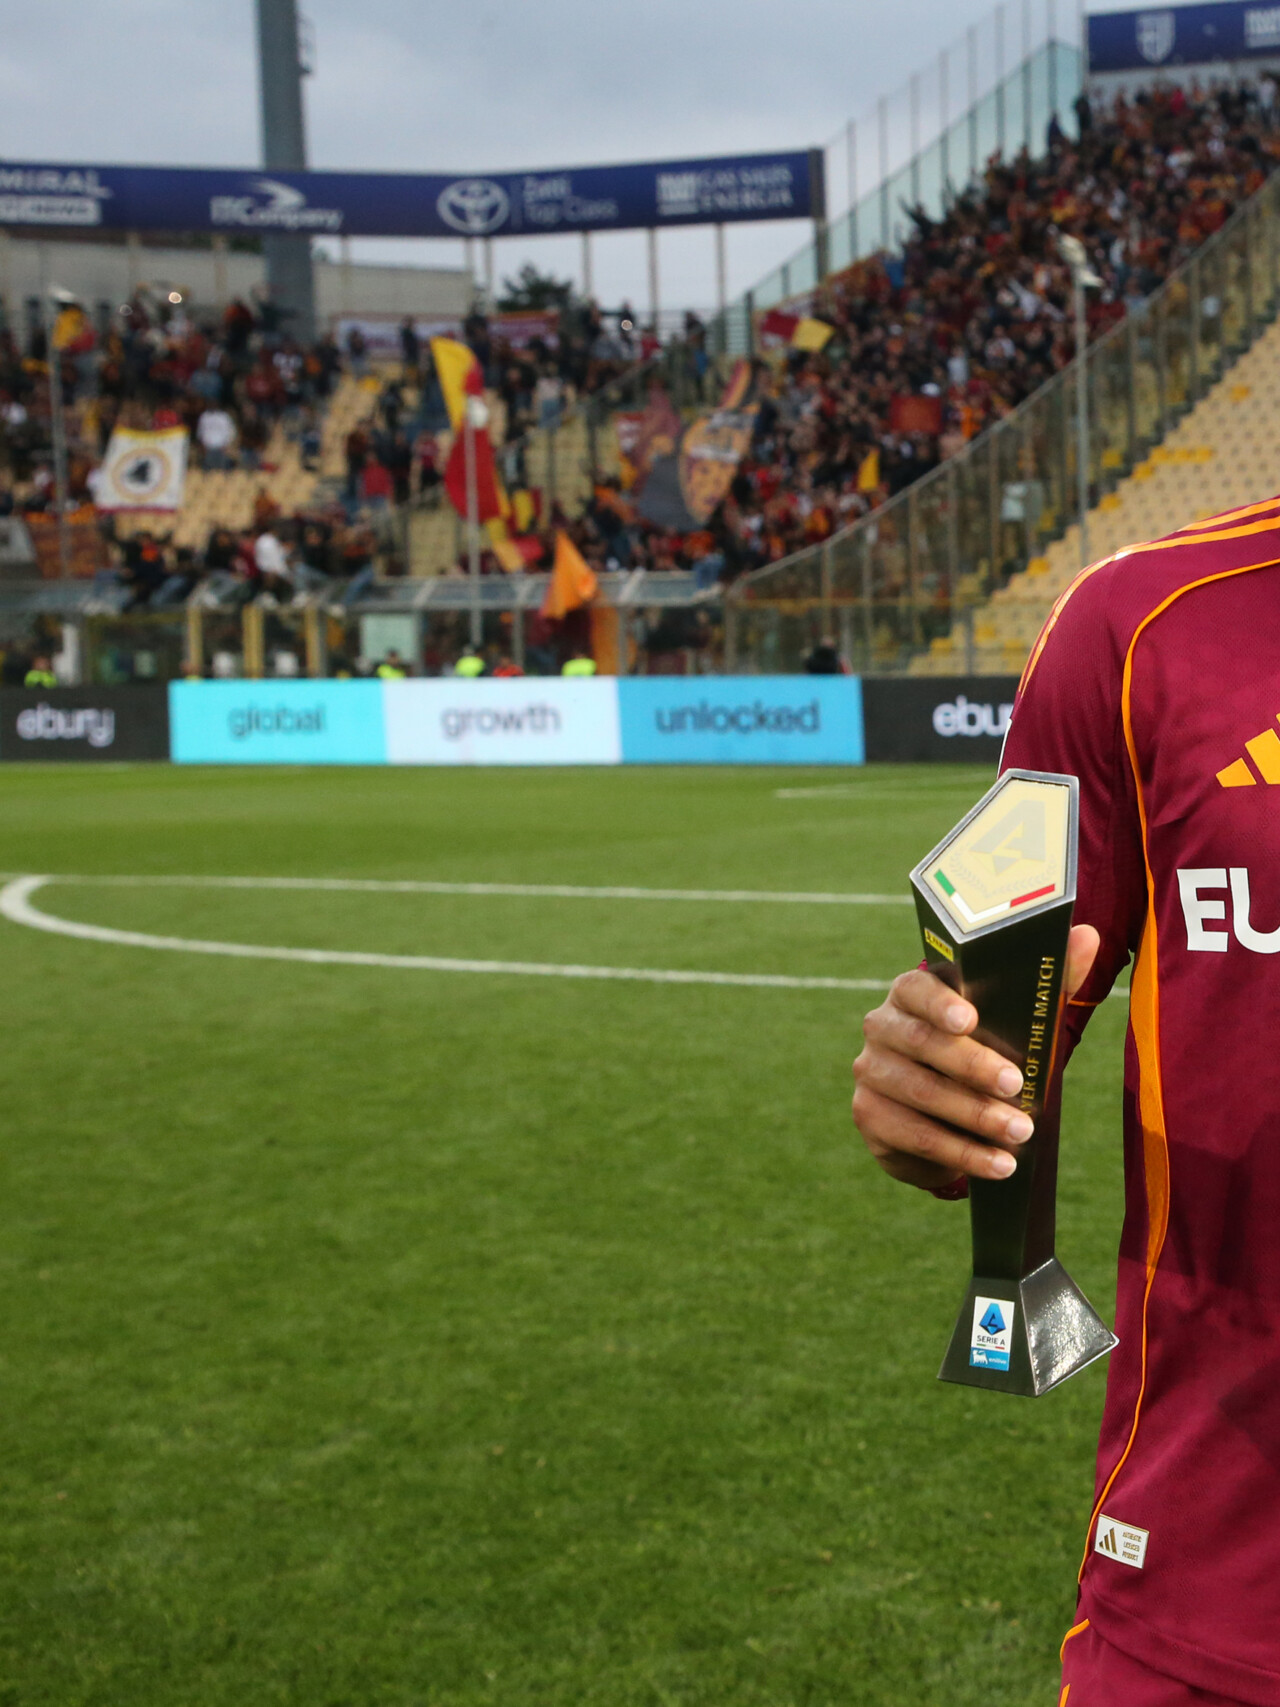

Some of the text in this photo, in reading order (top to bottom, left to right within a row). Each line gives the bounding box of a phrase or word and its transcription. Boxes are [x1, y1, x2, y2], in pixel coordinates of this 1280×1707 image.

[16, 702, 115, 747] ebury
[228, 699, 820, 741] global growth unlocked
[932, 694, 1013, 737] ebu
[1033, 956, 1055, 1017] MATCH
[1028, 1021, 1046, 1052] THE
[1025, 1056, 1040, 1078] OF
[977, 1335, 1006, 1346] SERIE A
